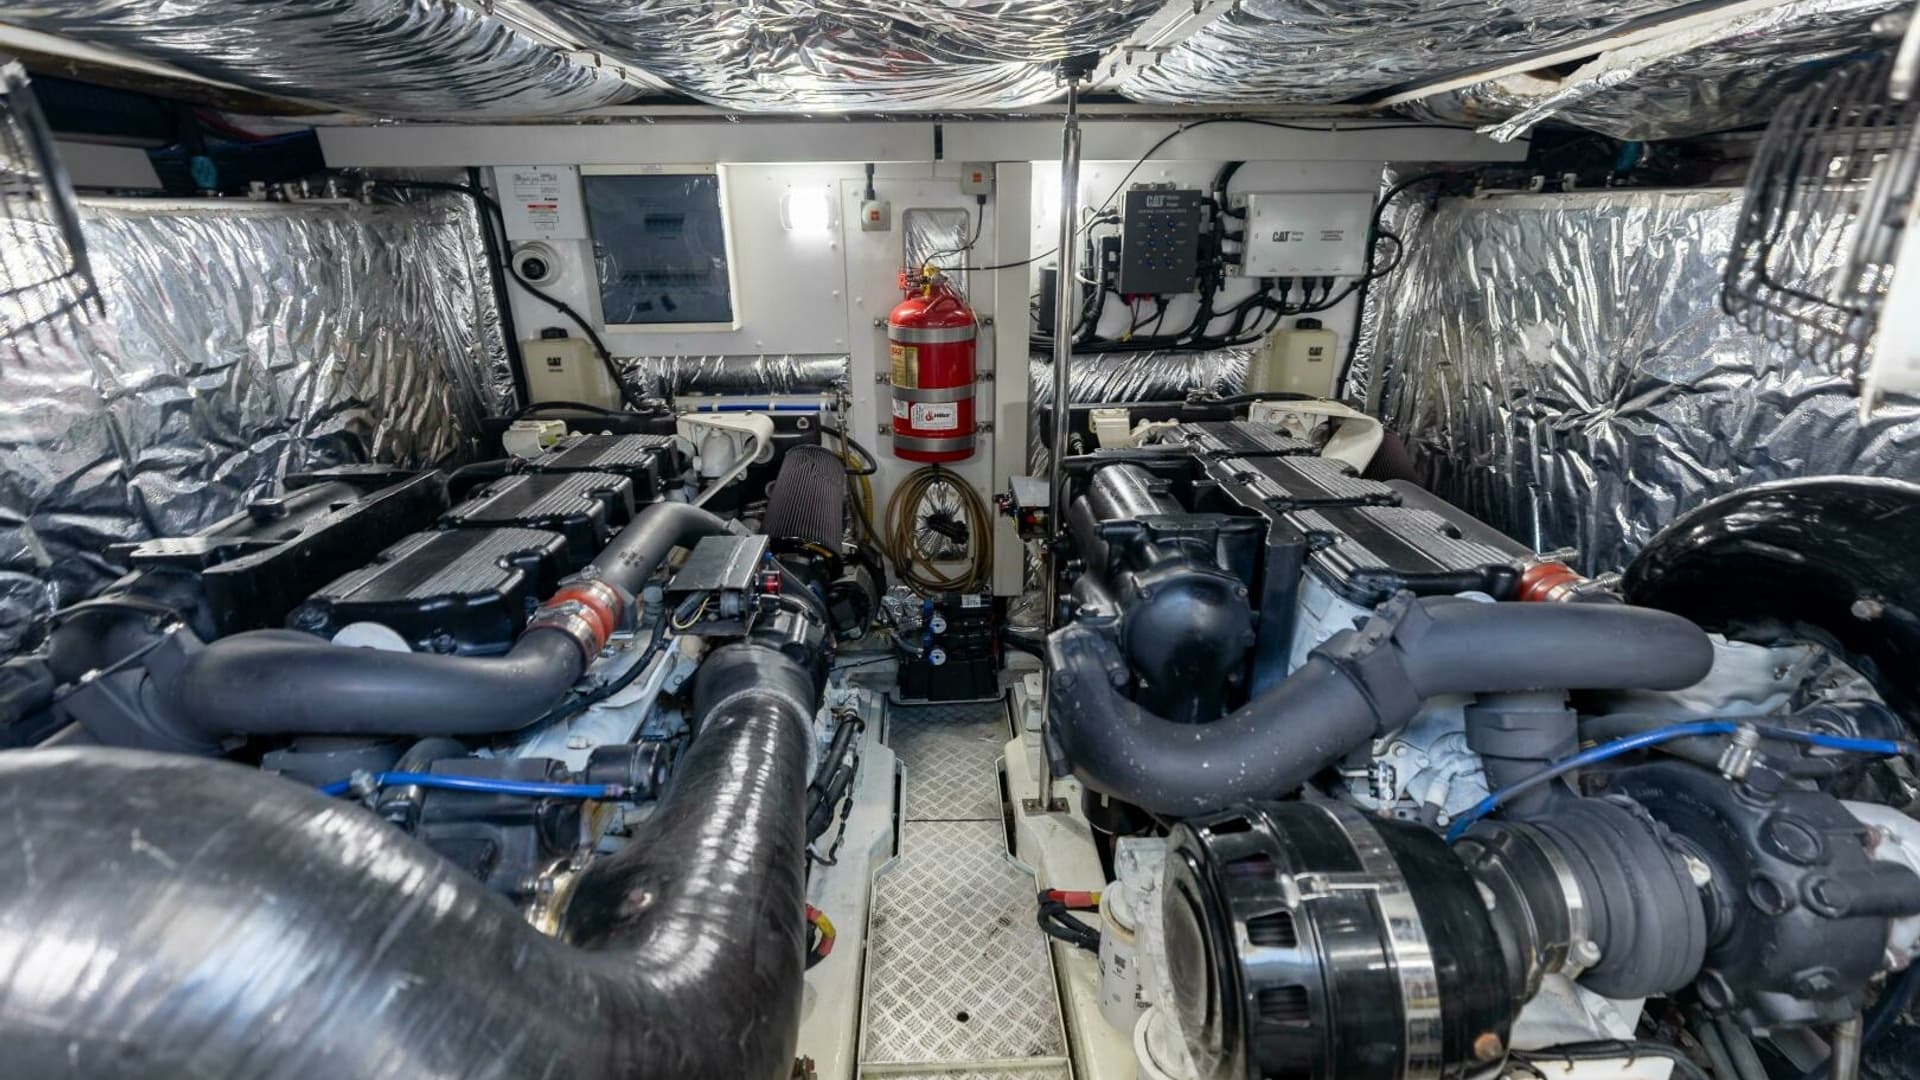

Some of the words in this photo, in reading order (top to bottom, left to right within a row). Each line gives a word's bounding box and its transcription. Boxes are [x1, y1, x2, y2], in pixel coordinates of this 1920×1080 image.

[1146, 195, 1166, 207] CAT
[1272, 231, 1290, 242] CAT
[1309, 346, 1323, 356] CAT
[547, 357, 561, 366] CAT
